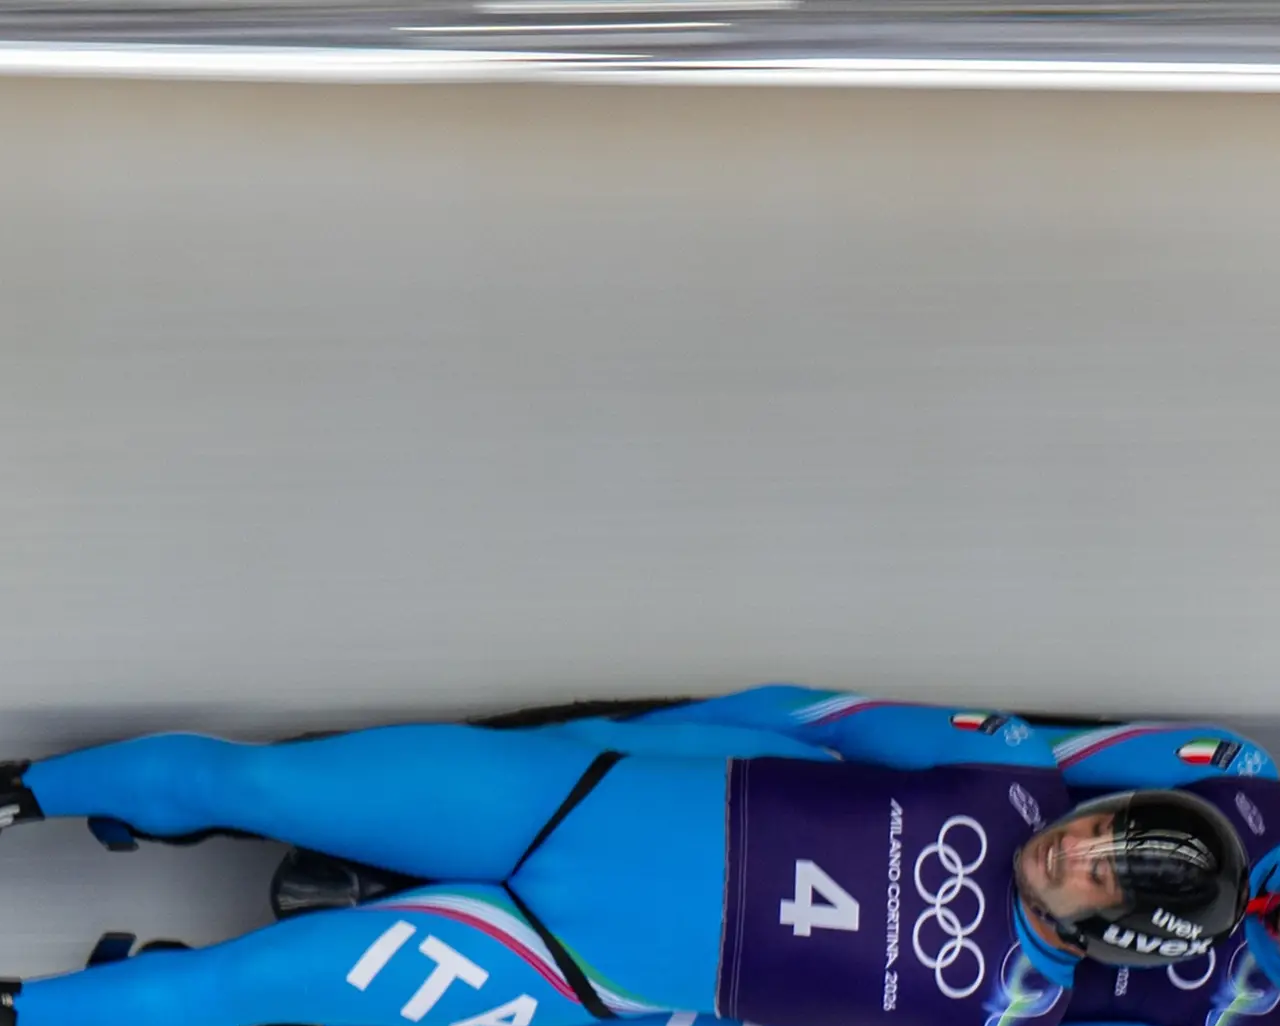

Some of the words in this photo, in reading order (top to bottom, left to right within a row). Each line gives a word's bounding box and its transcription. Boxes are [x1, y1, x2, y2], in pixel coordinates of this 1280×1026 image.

[888, 798, 903, 882] MILANO
[780, 859, 860, 937] 4
[885, 882, 901, 969] CORTINA
[1151, 907, 1203, 940] uvex
[1103, 924, 1213, 957] uvex
